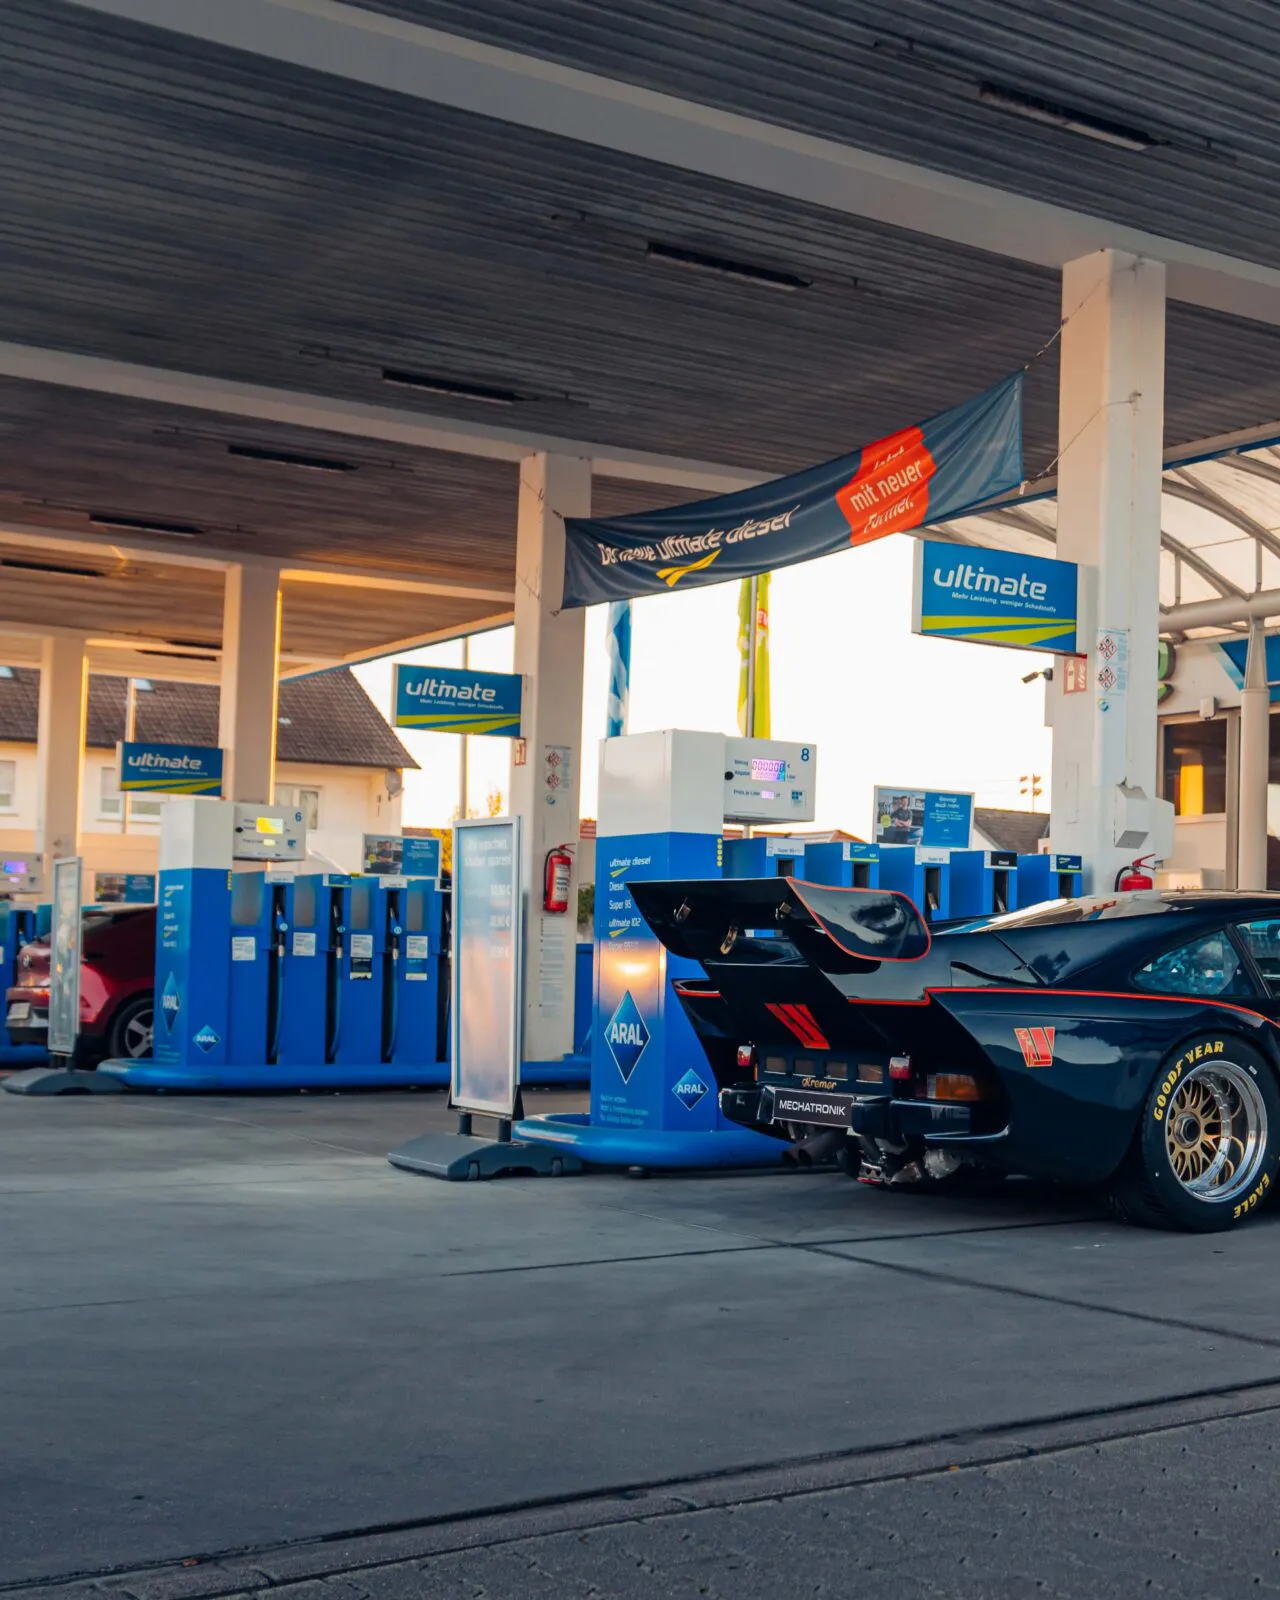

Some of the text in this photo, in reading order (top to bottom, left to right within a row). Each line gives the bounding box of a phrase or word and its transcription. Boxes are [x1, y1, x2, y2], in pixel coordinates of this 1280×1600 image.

[850, 460, 922, 512] mit neuer
[656, 528, 725, 561] ultimate
[725, 504, 801, 544] diesel
[933, 563, 1048, 601] ultimate
[951, 592, 969, 600] Mehr
[1000, 599, 1024, 608] weniger
[405, 678, 497, 702] ultimate
[127, 752, 202, 770] ultimate
[801, 747, 810, 762] 8
[295, 812, 302, 822] 6
[609, 856, 652, 868] ultimate diesel
[609, 881, 625, 892] Diesel
[609, 899, 624, 911] Super
[196, 1034, 217, 1043] ARAL
[610, 1022, 644, 1046] ARAL
[676, 1083, 704, 1094] ARAL
[779, 1099, 847, 1116] MECHATRONIK
[1233, 1172, 1271, 1219] EAGLE
